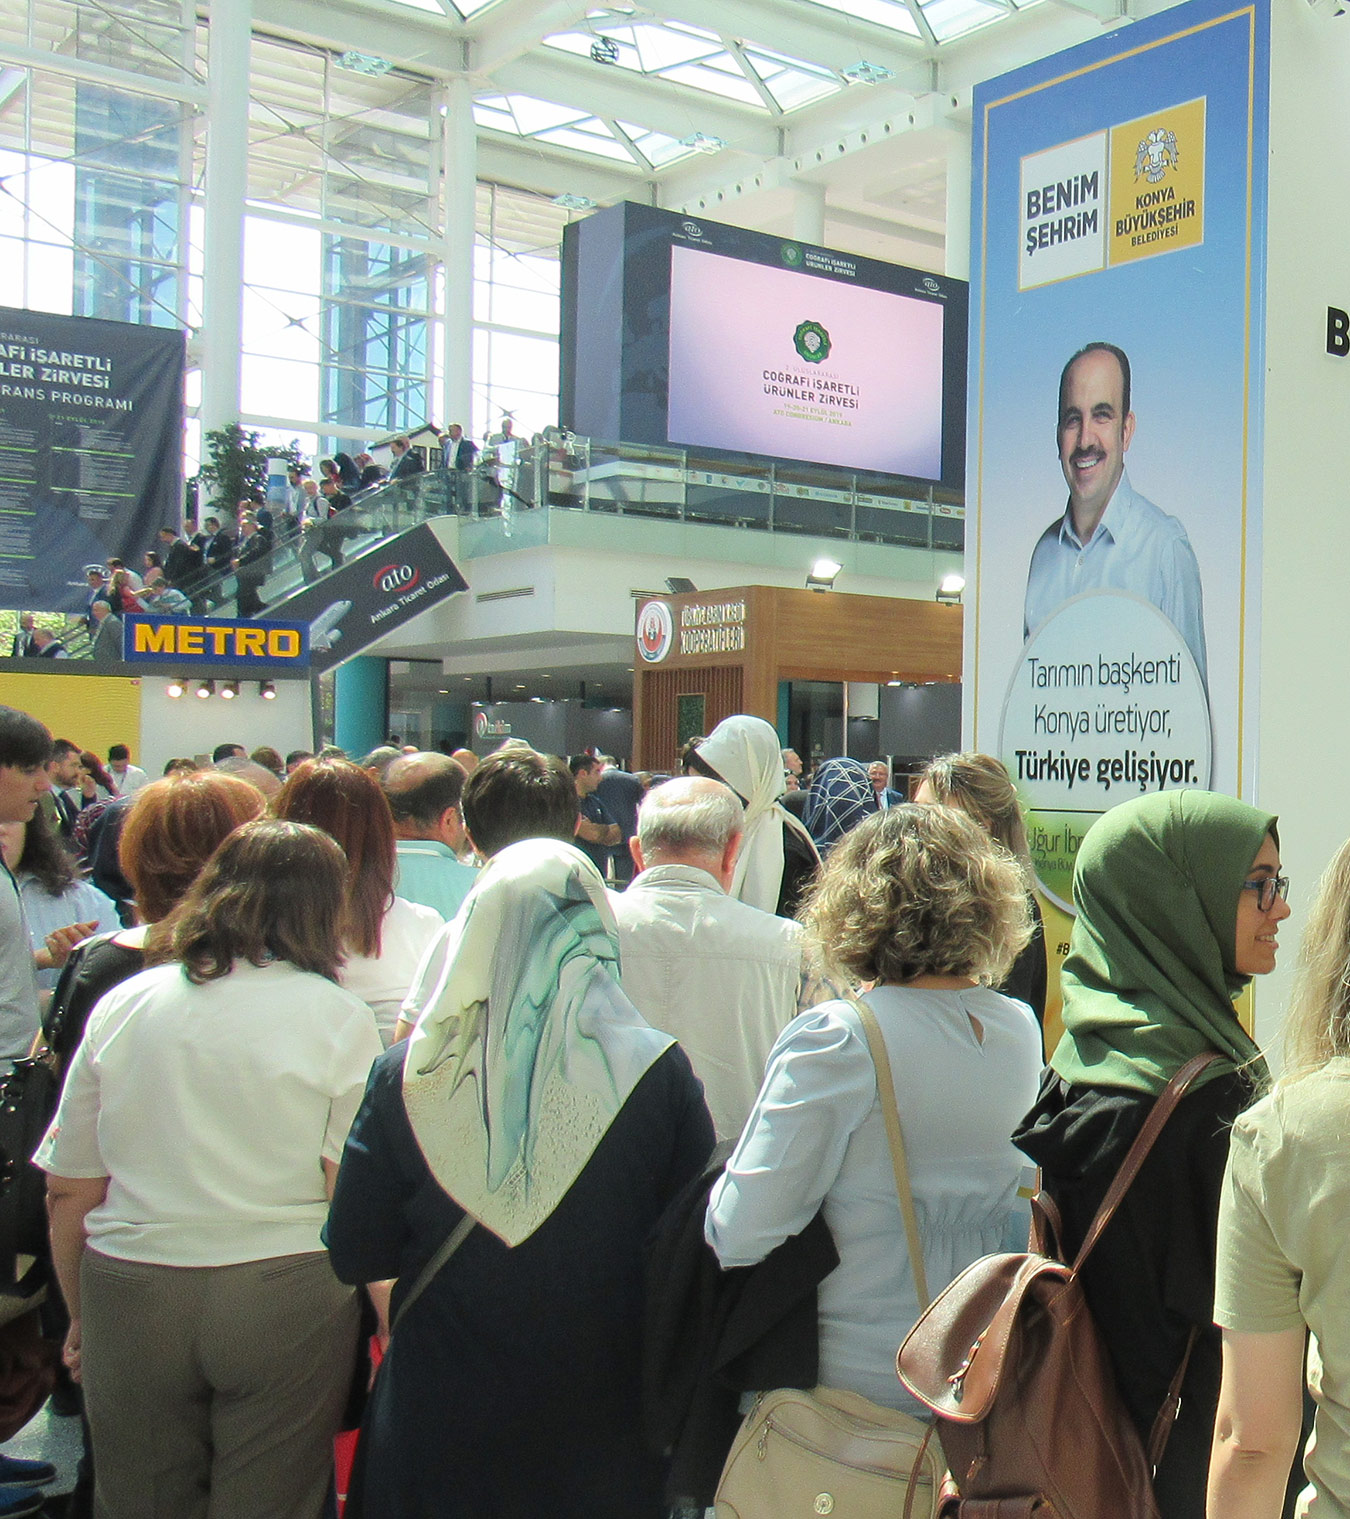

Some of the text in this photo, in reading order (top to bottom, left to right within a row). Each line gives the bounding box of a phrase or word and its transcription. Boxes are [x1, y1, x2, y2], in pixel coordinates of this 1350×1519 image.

[1136, 186, 1175, 210] KONYA
[1116, 198, 1195, 237] BÜYÜKŞEHİR
[1131, 225, 1178, 247] BELEDİYESİ
[1, 384, 133, 412] RANS PROGRAMI
[370, 603, 400, 624] Ankara
[134, 623, 301, 658] METRO
[1028, 652, 1181, 693] Tarımın başkenti
[1034, 702, 1172, 742] Konya üretiyor,
[1015, 750, 1198, 791] Türkiye gelişiyor.
